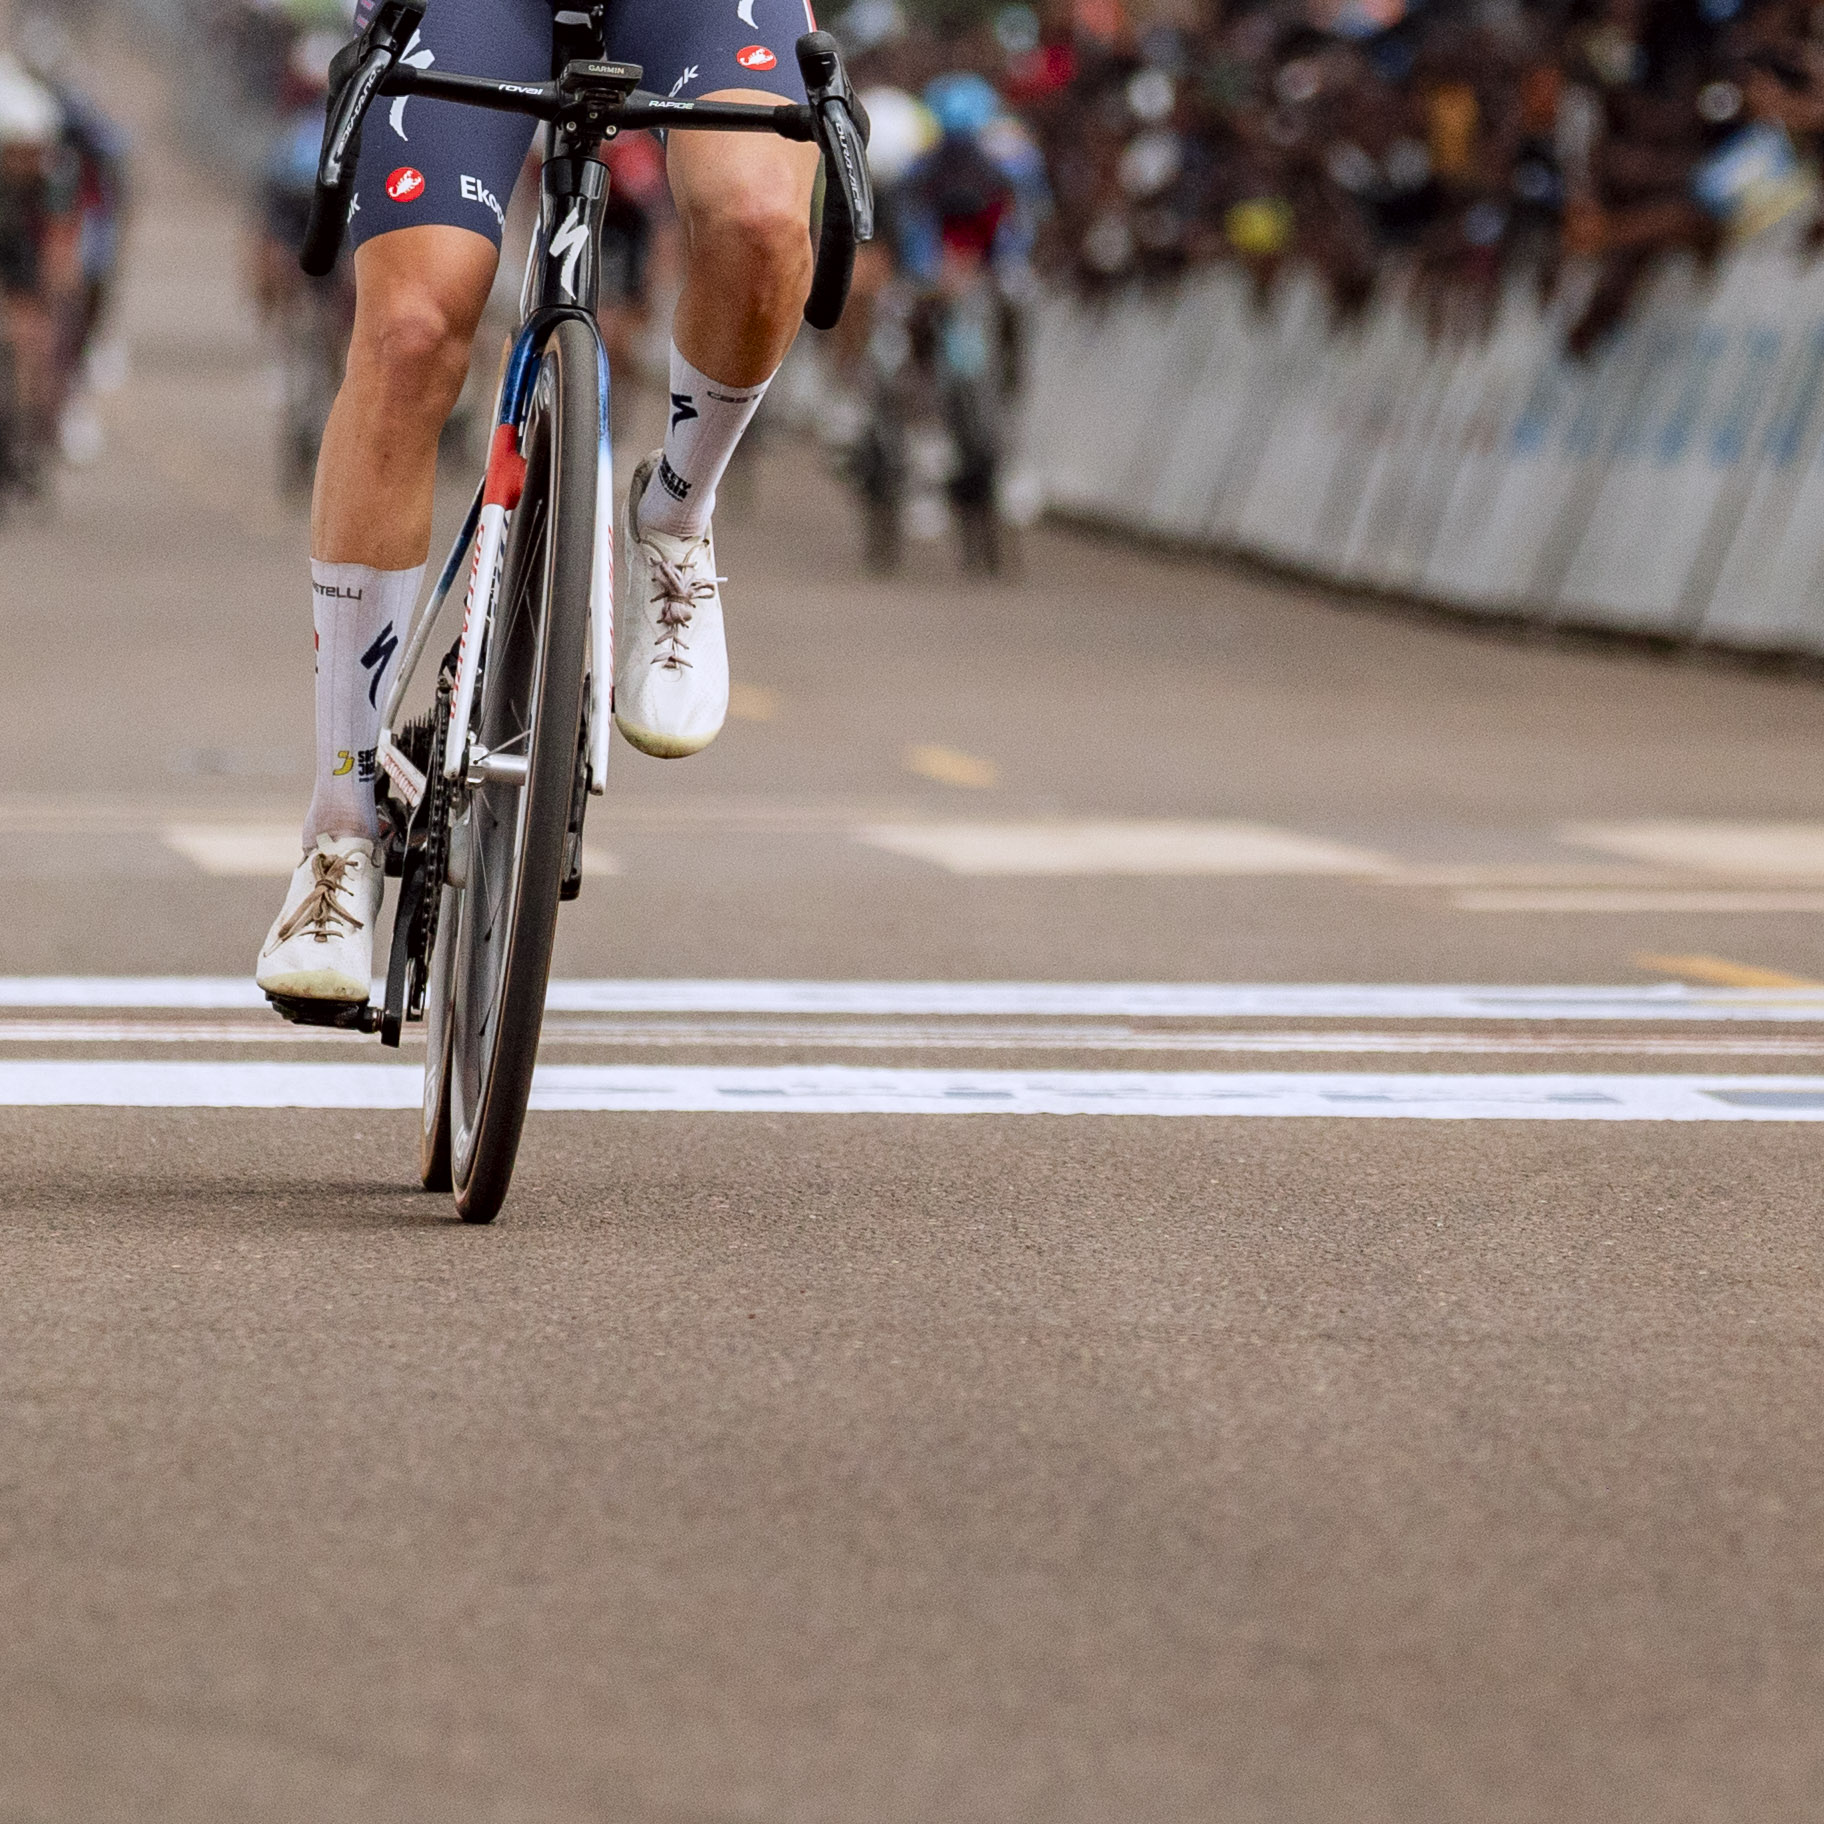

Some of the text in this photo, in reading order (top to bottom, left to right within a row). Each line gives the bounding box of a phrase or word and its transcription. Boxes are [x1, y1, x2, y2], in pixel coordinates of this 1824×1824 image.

[588, 64, 625, 75] GARMIN
[498, 83, 543, 95] roval
[648, 100, 695, 110] RAPIDE
